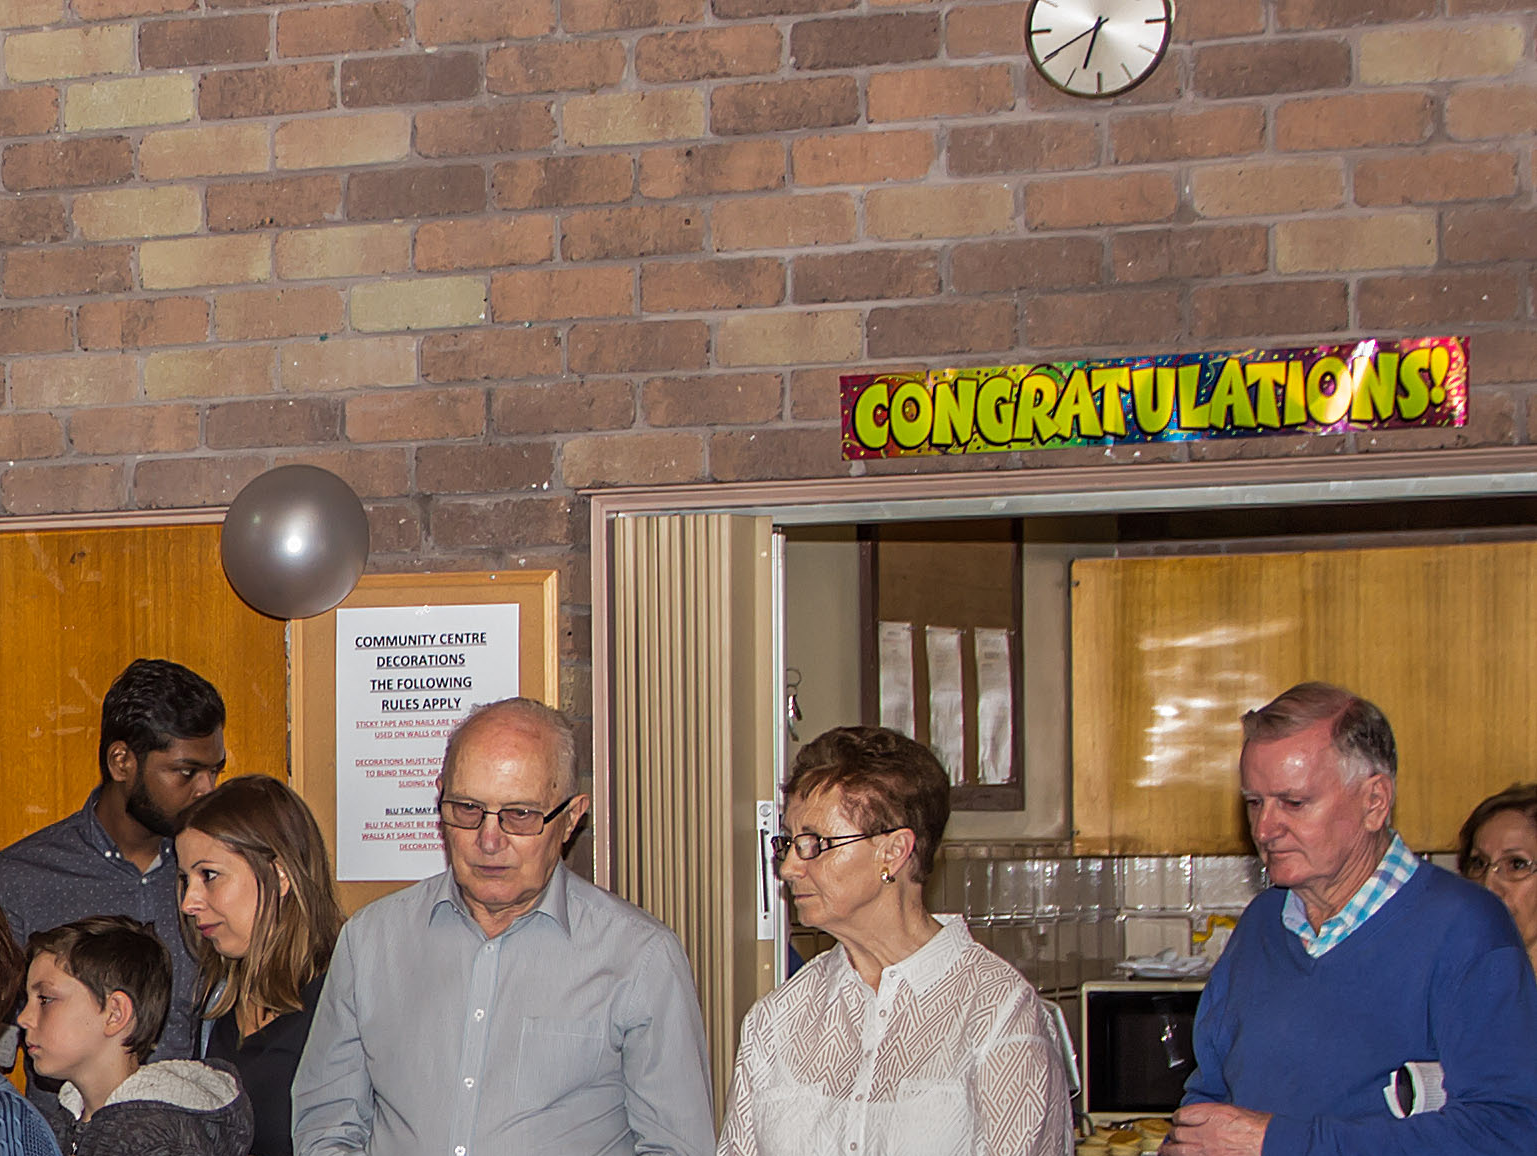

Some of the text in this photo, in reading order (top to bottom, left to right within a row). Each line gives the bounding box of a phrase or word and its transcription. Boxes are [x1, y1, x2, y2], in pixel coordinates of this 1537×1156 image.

[852, 347, 1450, 450] CONGRATULATIONS!
[355, 631, 487, 648] COMMUNITY CENTRE
[376, 653, 466, 667] DECORATIONS
[370, 676, 472, 691] THE FOLLOWING
[381, 697, 462, 711] RULES APPLY
[356, 721, 378, 729] STICKY
[381, 720, 396, 728] TAPE
[416, 719, 434, 727] NAILS
[375, 731, 393, 739] USED
[394, 731, 405, 739] ON
[431, 730, 441, 738] OR
[355, 757, 443, 767] DECORATIONS MUST NOT
[366, 770, 375, 778] TO
[398, 780, 425, 788] SLIDING
[415, 807, 433, 815] MAY
[365, 822, 378, 830] BLU
[395, 821, 414, 829] MUST
[361, 833, 385, 841] WALLS
[396, 832, 417, 840] SAME
